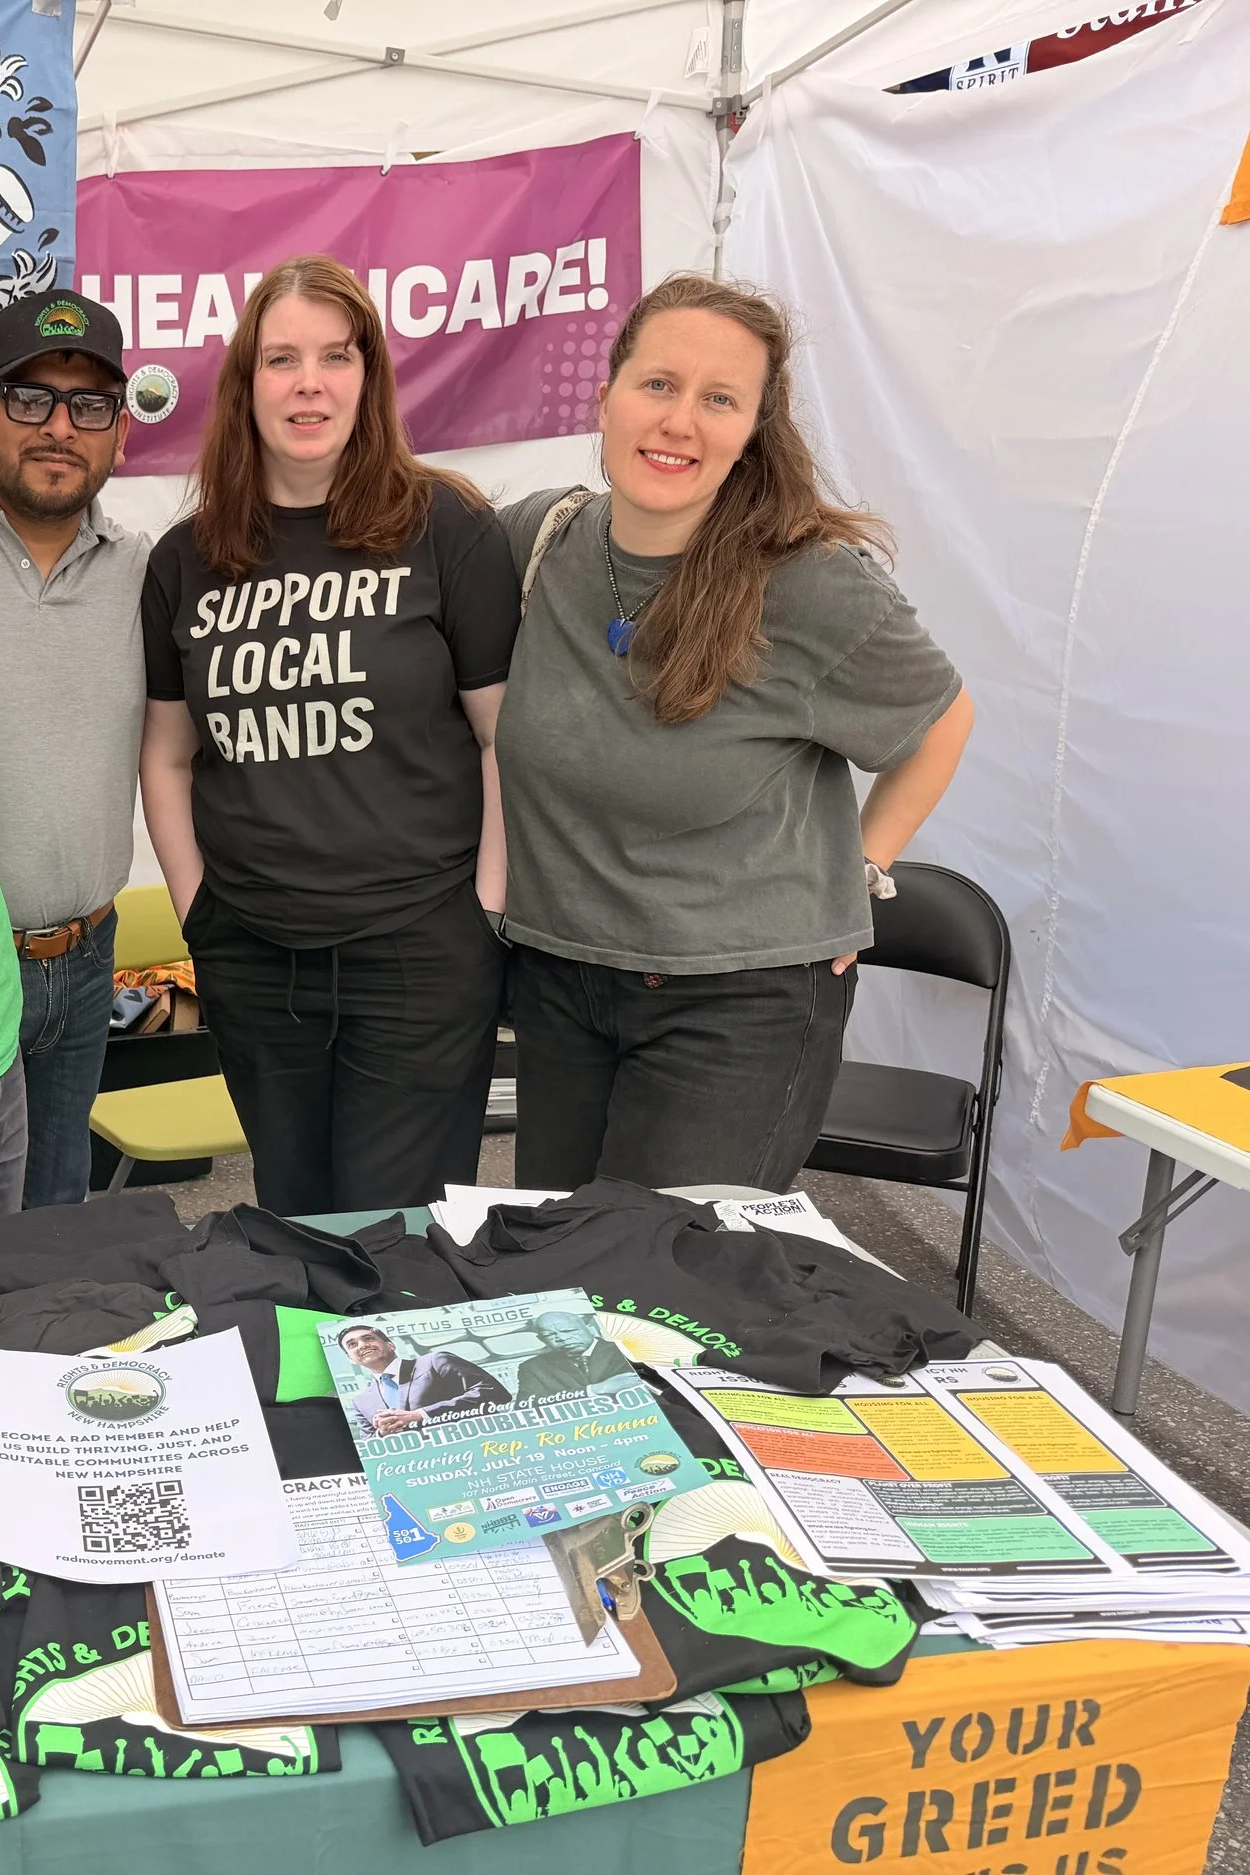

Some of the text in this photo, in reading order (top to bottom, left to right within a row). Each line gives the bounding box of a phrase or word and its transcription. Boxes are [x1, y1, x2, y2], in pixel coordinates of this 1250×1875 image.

[82, 238, 608, 349] HEACARE!
[189, 567, 411, 639] SUPPORT
[207, 630, 367, 698] LOCAL
[206, 697, 375, 763] BANDS
[755, 1204, 801, 1216] ACTION
[616, 1299, 638, 1312] &
[387, 1307, 534, 1336] PETTUS BRIDGE
[56, 1365, 89, 1389] RIGHTS
[102, 1360, 173, 1381] DEMOCRACY
[67, 1405, 170, 1429] NEW HAMPSHIRE
[408, 1388, 587, 1429] a national day of action
[70, 1434, 101, 1442] RAD
[105, 1431, 165, 1441] MEMBER
[170, 1427, 200, 1437] AND
[205, 1418, 240, 1432] HELP
[26, 1445, 70, 1454] BUILD
[201, 1434, 232, 1445] AND
[74, 1453, 183, 1466] COMMUNITIES
[188, 1444, 250, 1459] ACROSS
[375, 1413, 660, 1481] featuring Rep. Ro Khanna
[55, 1465, 183, 1479] NEW HAMPSHIRE
[406, 1433, 649, 1488] SUNDAY, JULY 19 Noon 4pm
[467, 1478, 493, 1490] NH
[497, 1465, 546, 1486] STATE
[550, 1454, 608, 1476] HOUSE
[282, 1477, 343, 1494] CRACY
[462, 1460, 623, 1499] 107 North Main Street, Concord
[544, 1479, 590, 1494] ENGAGE
[601, 1472, 620, 1481] NH
[792, 1474, 842, 1484] DEMOCRACY
[631, 1487, 667, 1499] Action
[56, 1552, 226, 1566] radmovement.org/donate
[73, 1642, 101, 1664] &
[902, 1698, 1101, 1769] YOUR
[831, 1763, 1143, 1864] GREED
